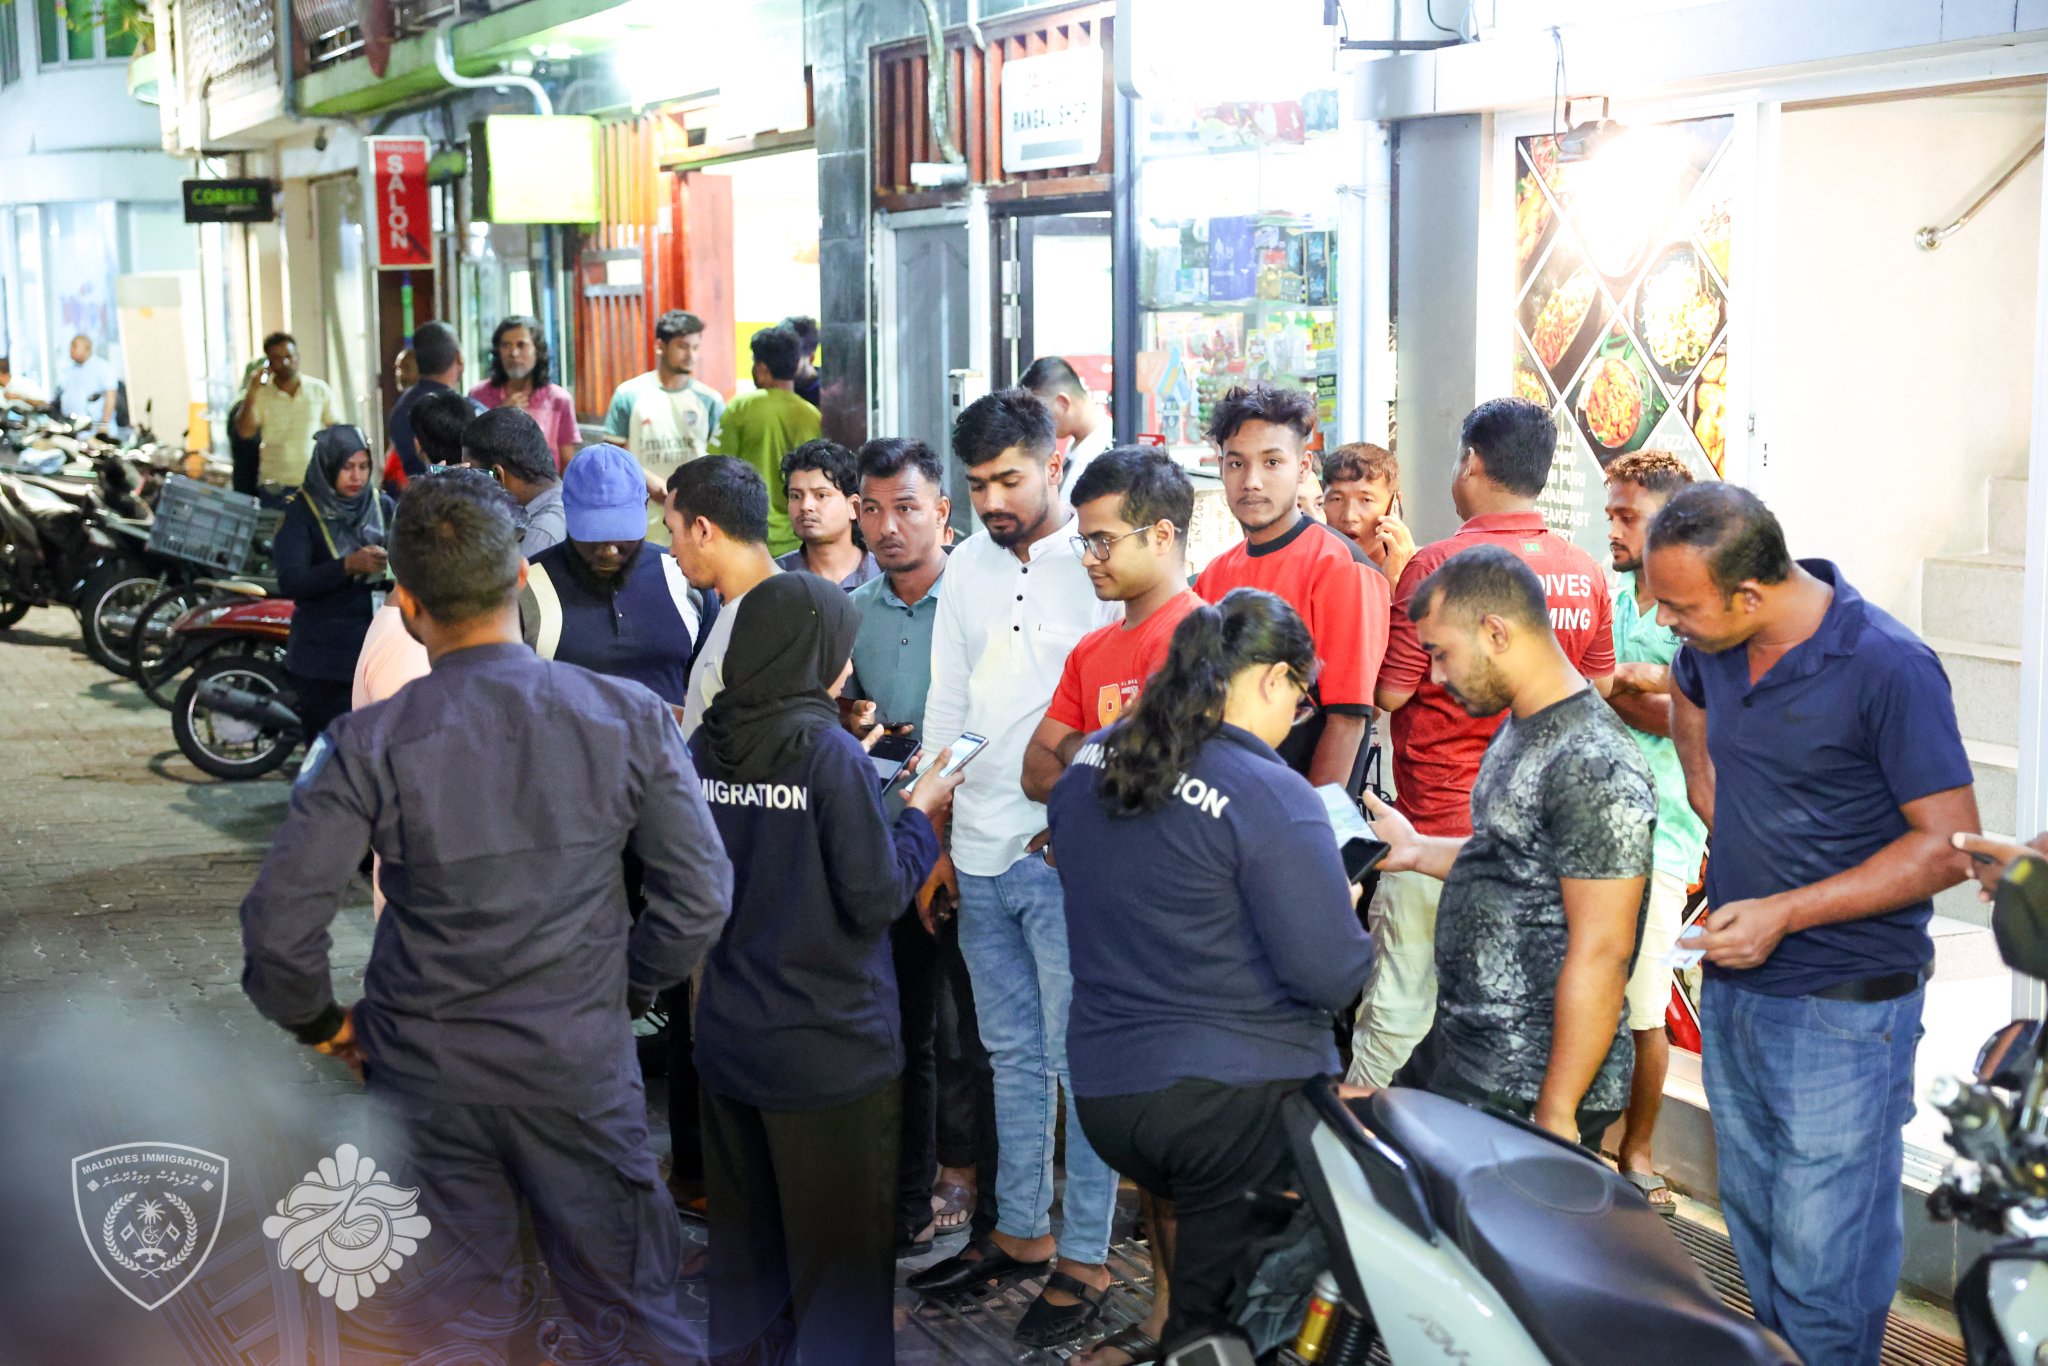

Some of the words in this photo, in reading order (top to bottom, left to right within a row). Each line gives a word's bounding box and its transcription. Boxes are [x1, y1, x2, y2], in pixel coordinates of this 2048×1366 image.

[191, 187, 259, 206] CORNER
[386, 154, 409, 249] SALON
[1557, 431, 1577, 448] ALI
[1656, 433, 1693, 451] PIZZA
[1560, 470, 1586, 488] PURI
